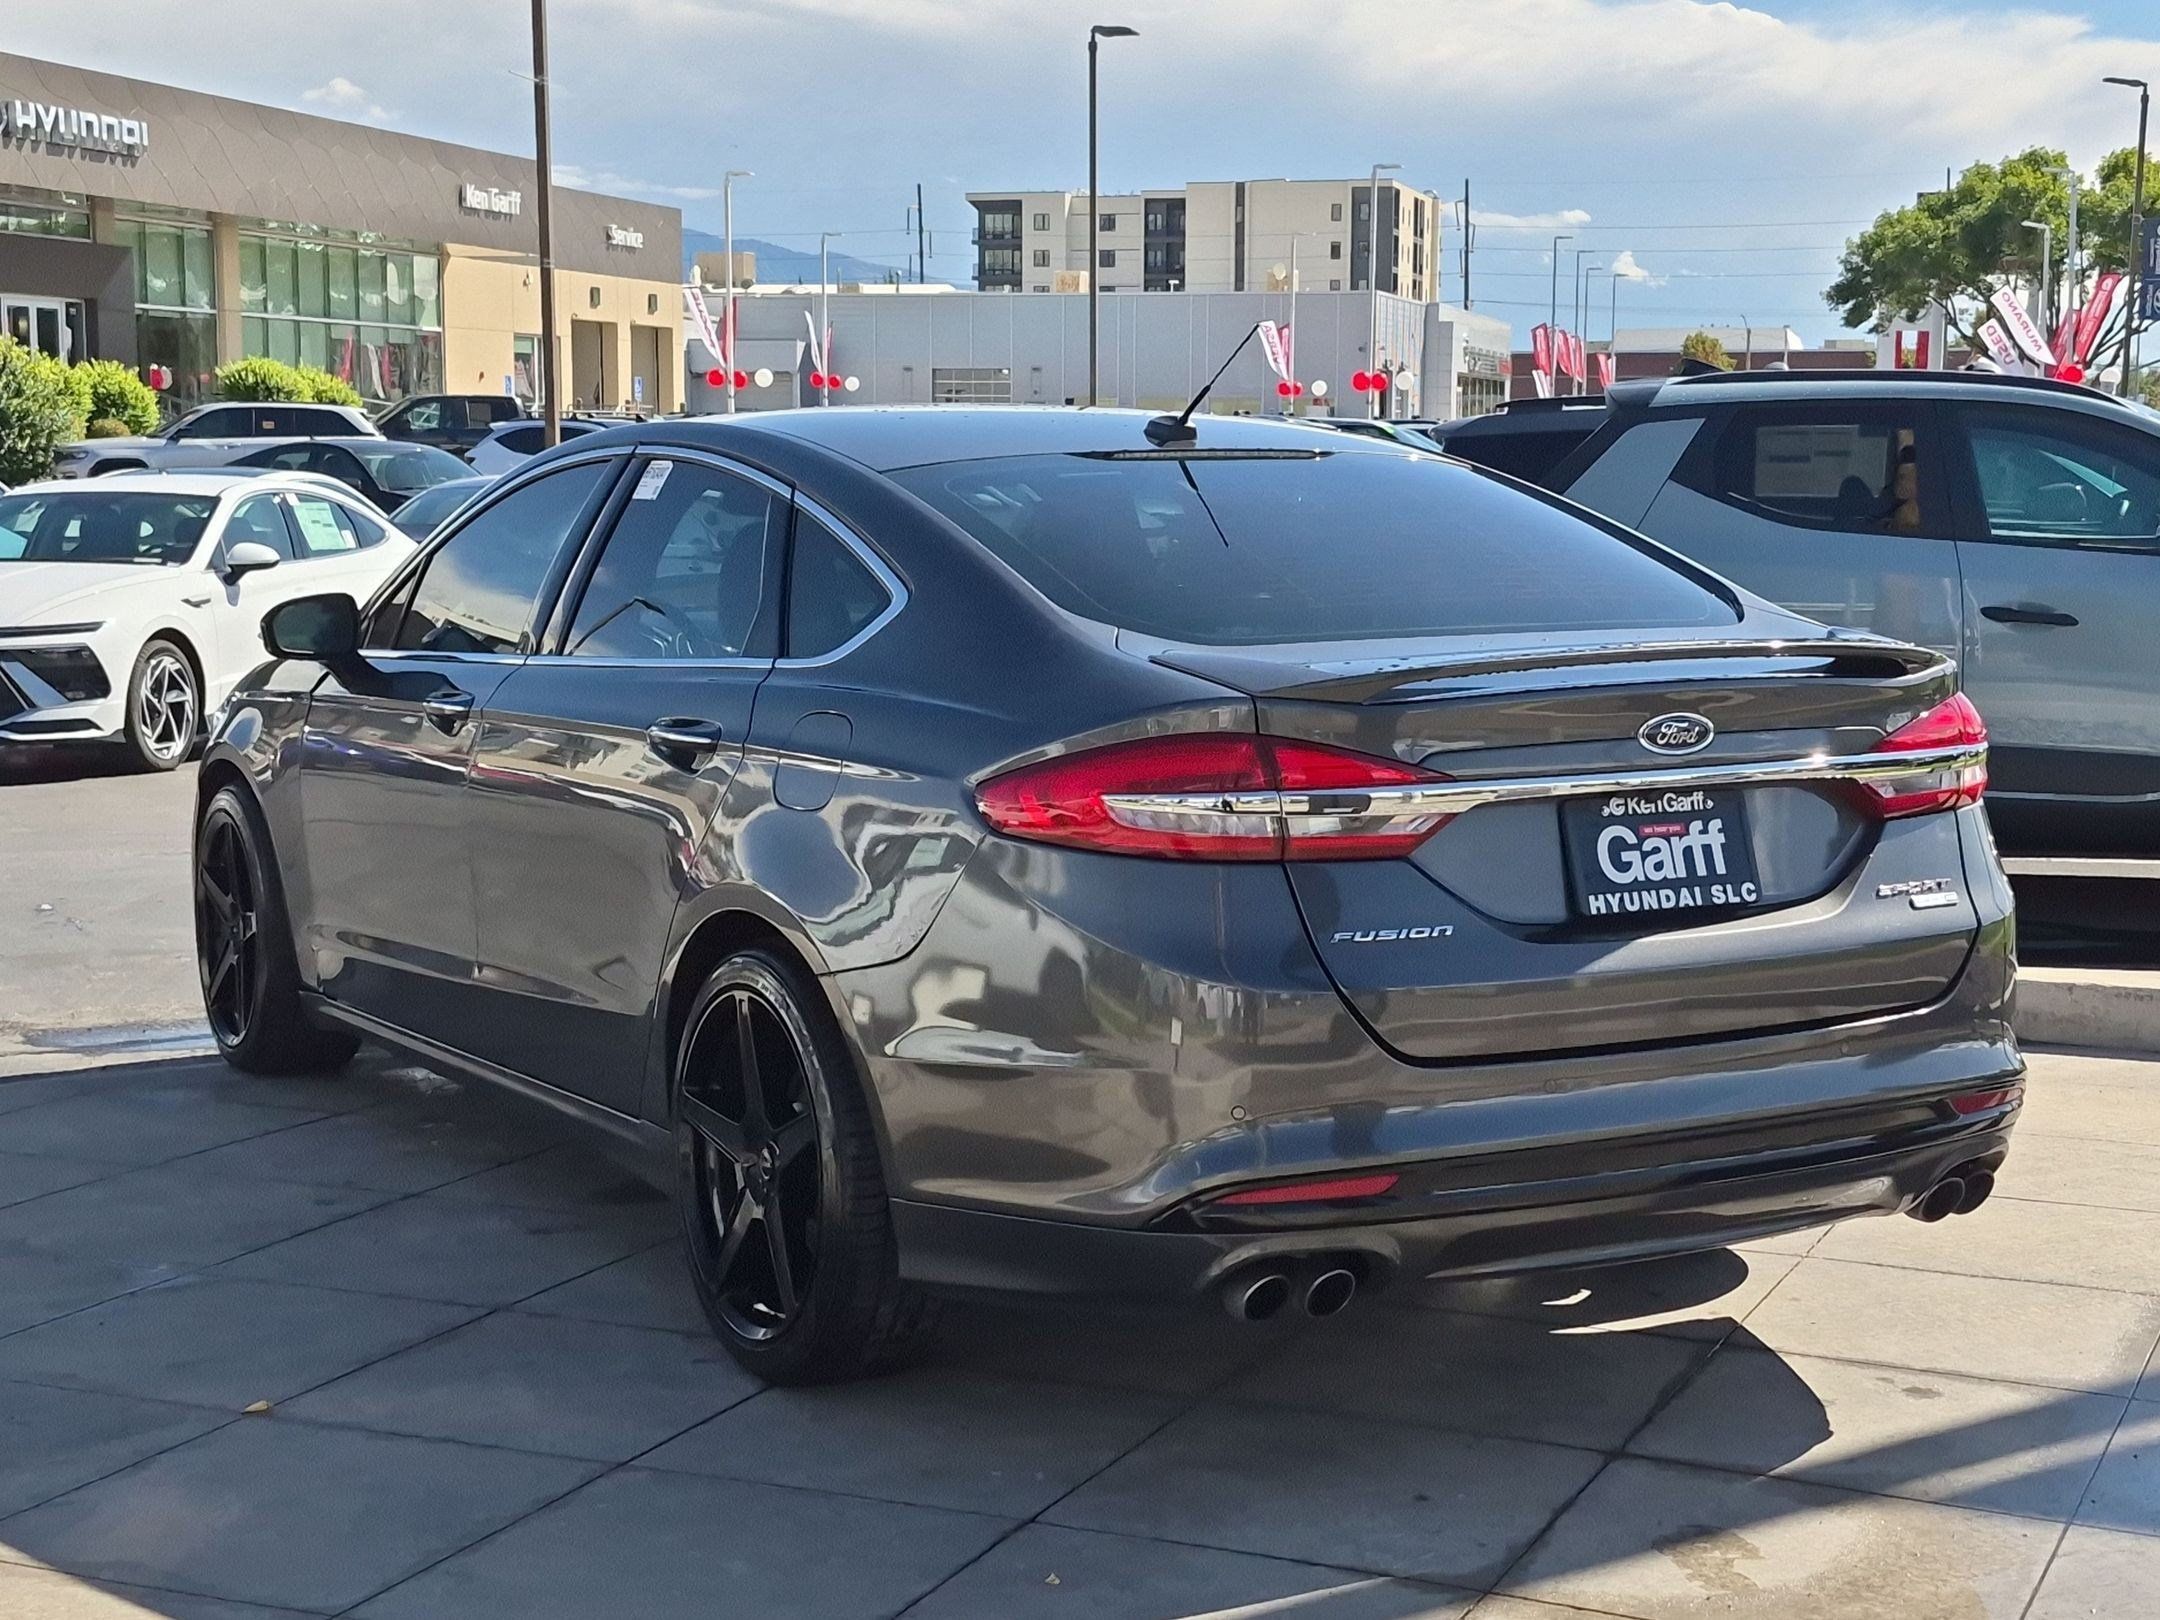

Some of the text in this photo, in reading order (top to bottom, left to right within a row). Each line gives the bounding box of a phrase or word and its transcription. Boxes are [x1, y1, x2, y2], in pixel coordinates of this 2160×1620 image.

[15, 99, 149, 147] HYUNDAI
[465, 183, 522, 216] Ken Garff
[608, 223, 644, 249] Service
[1656, 721, 1700, 745] Ford
[1662, 790, 1705, 813] Garff
[1596, 818, 1727, 885] Garff
[1588, 882, 1758, 915] HYUNDAI SLC
[1329, 925, 1454, 944] FUSION
